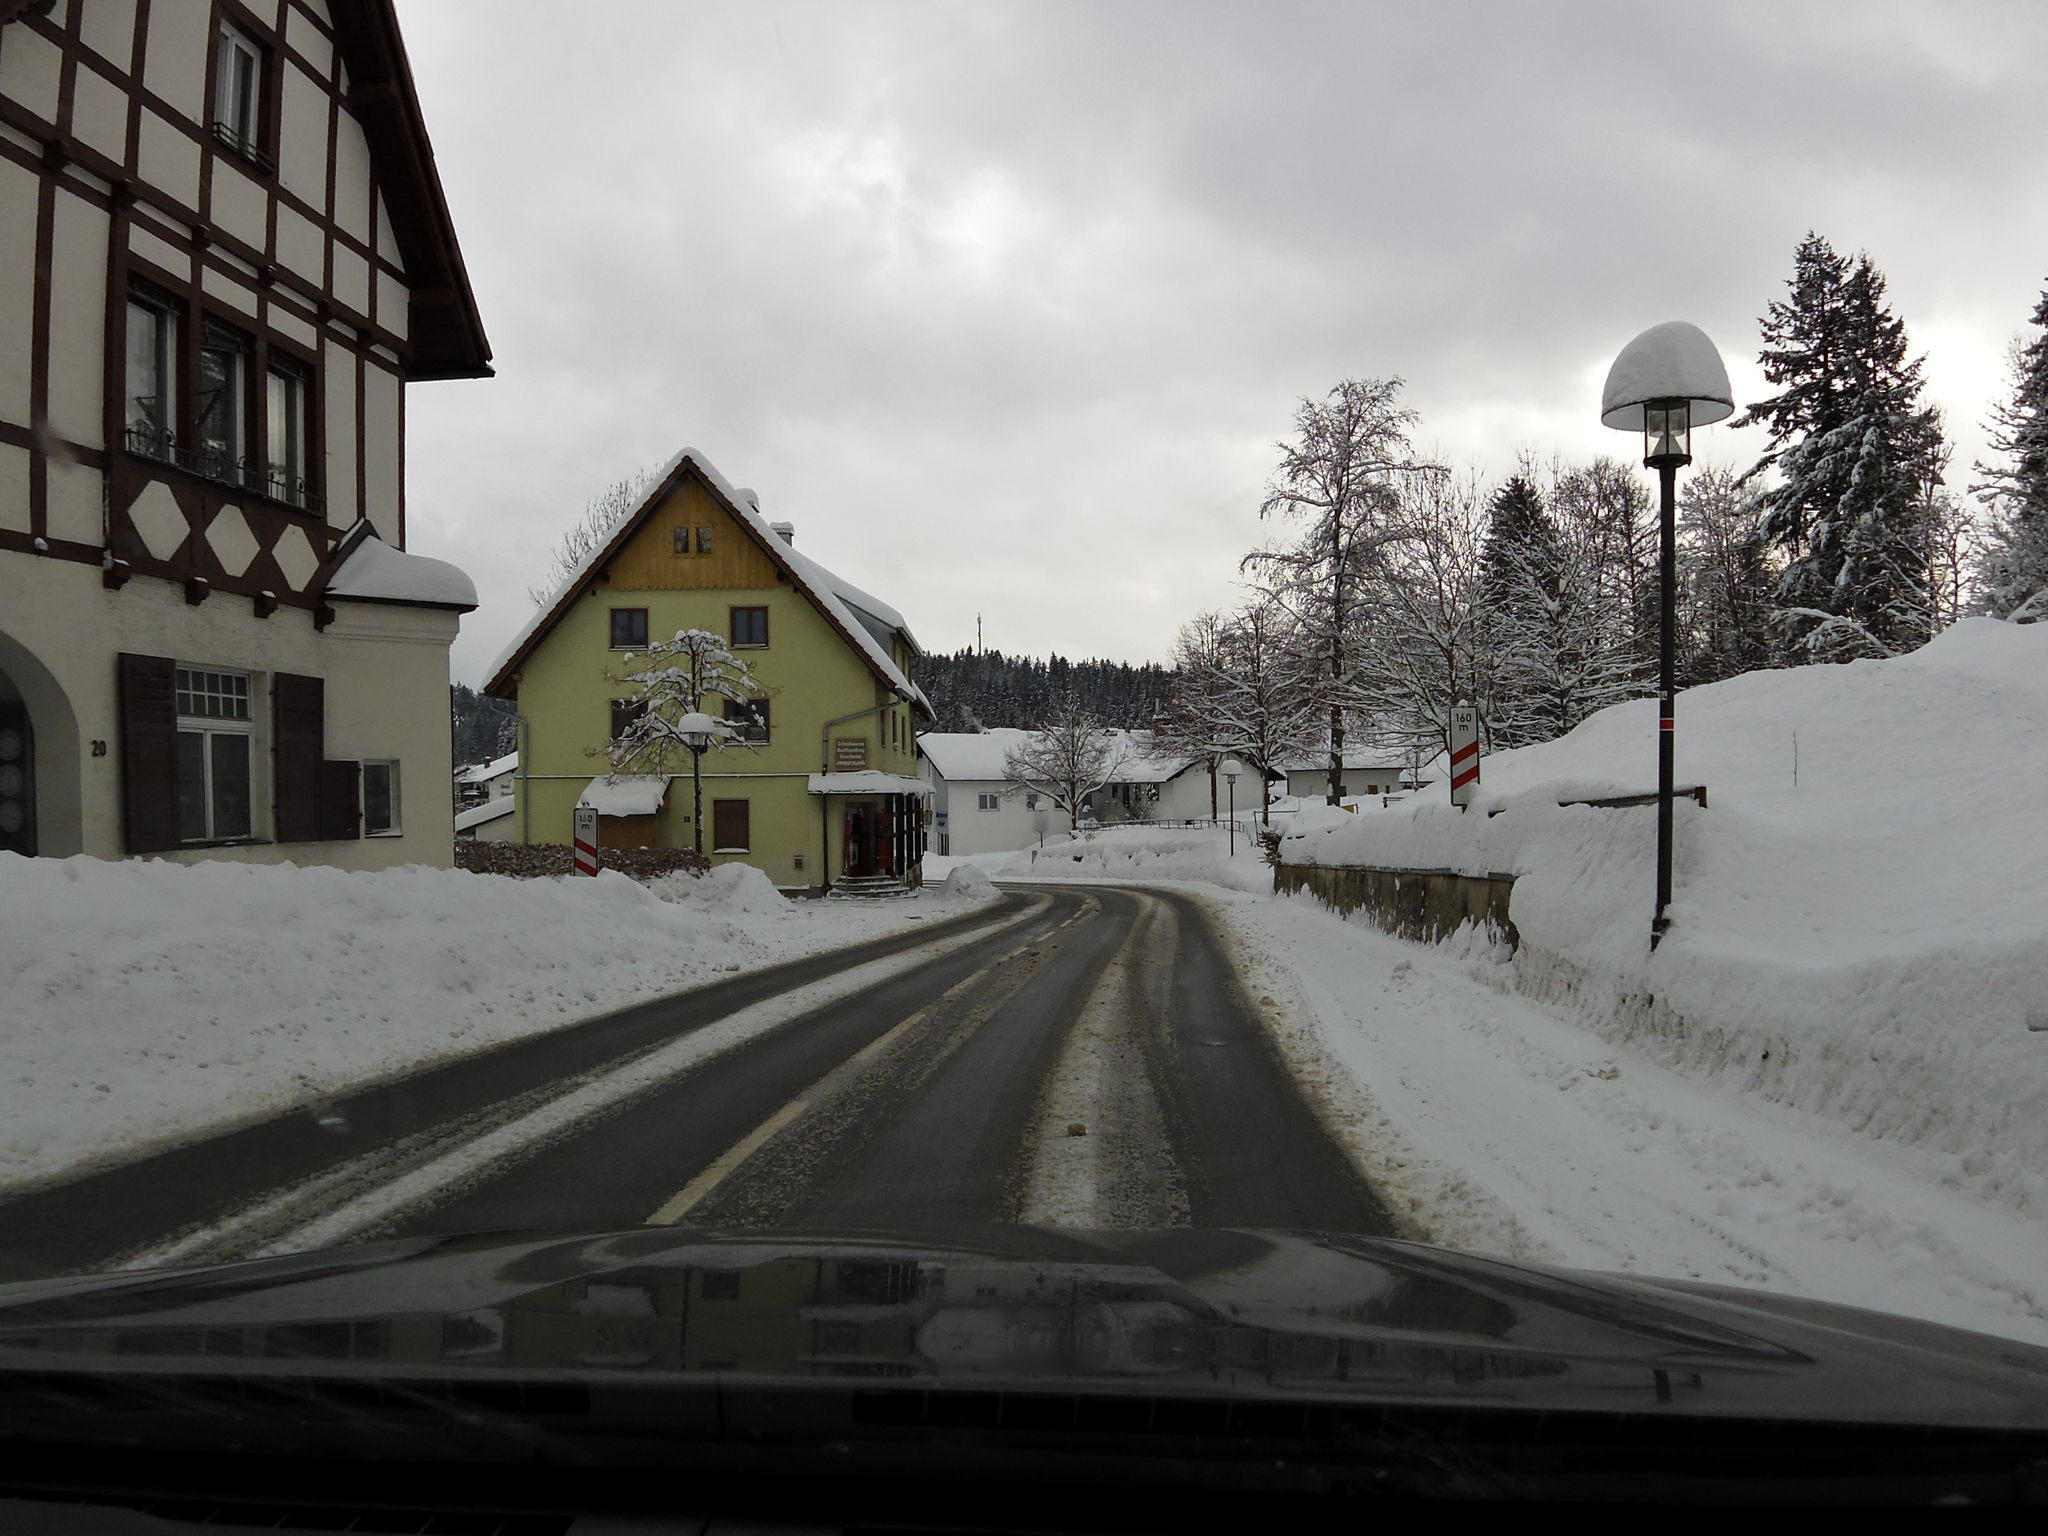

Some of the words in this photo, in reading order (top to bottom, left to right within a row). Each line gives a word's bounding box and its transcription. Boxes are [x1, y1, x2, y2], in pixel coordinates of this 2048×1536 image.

[1456, 713, 1472, 722] 160
[90, 740, 107, 757] 20
[579, 814, 593, 823] 160
